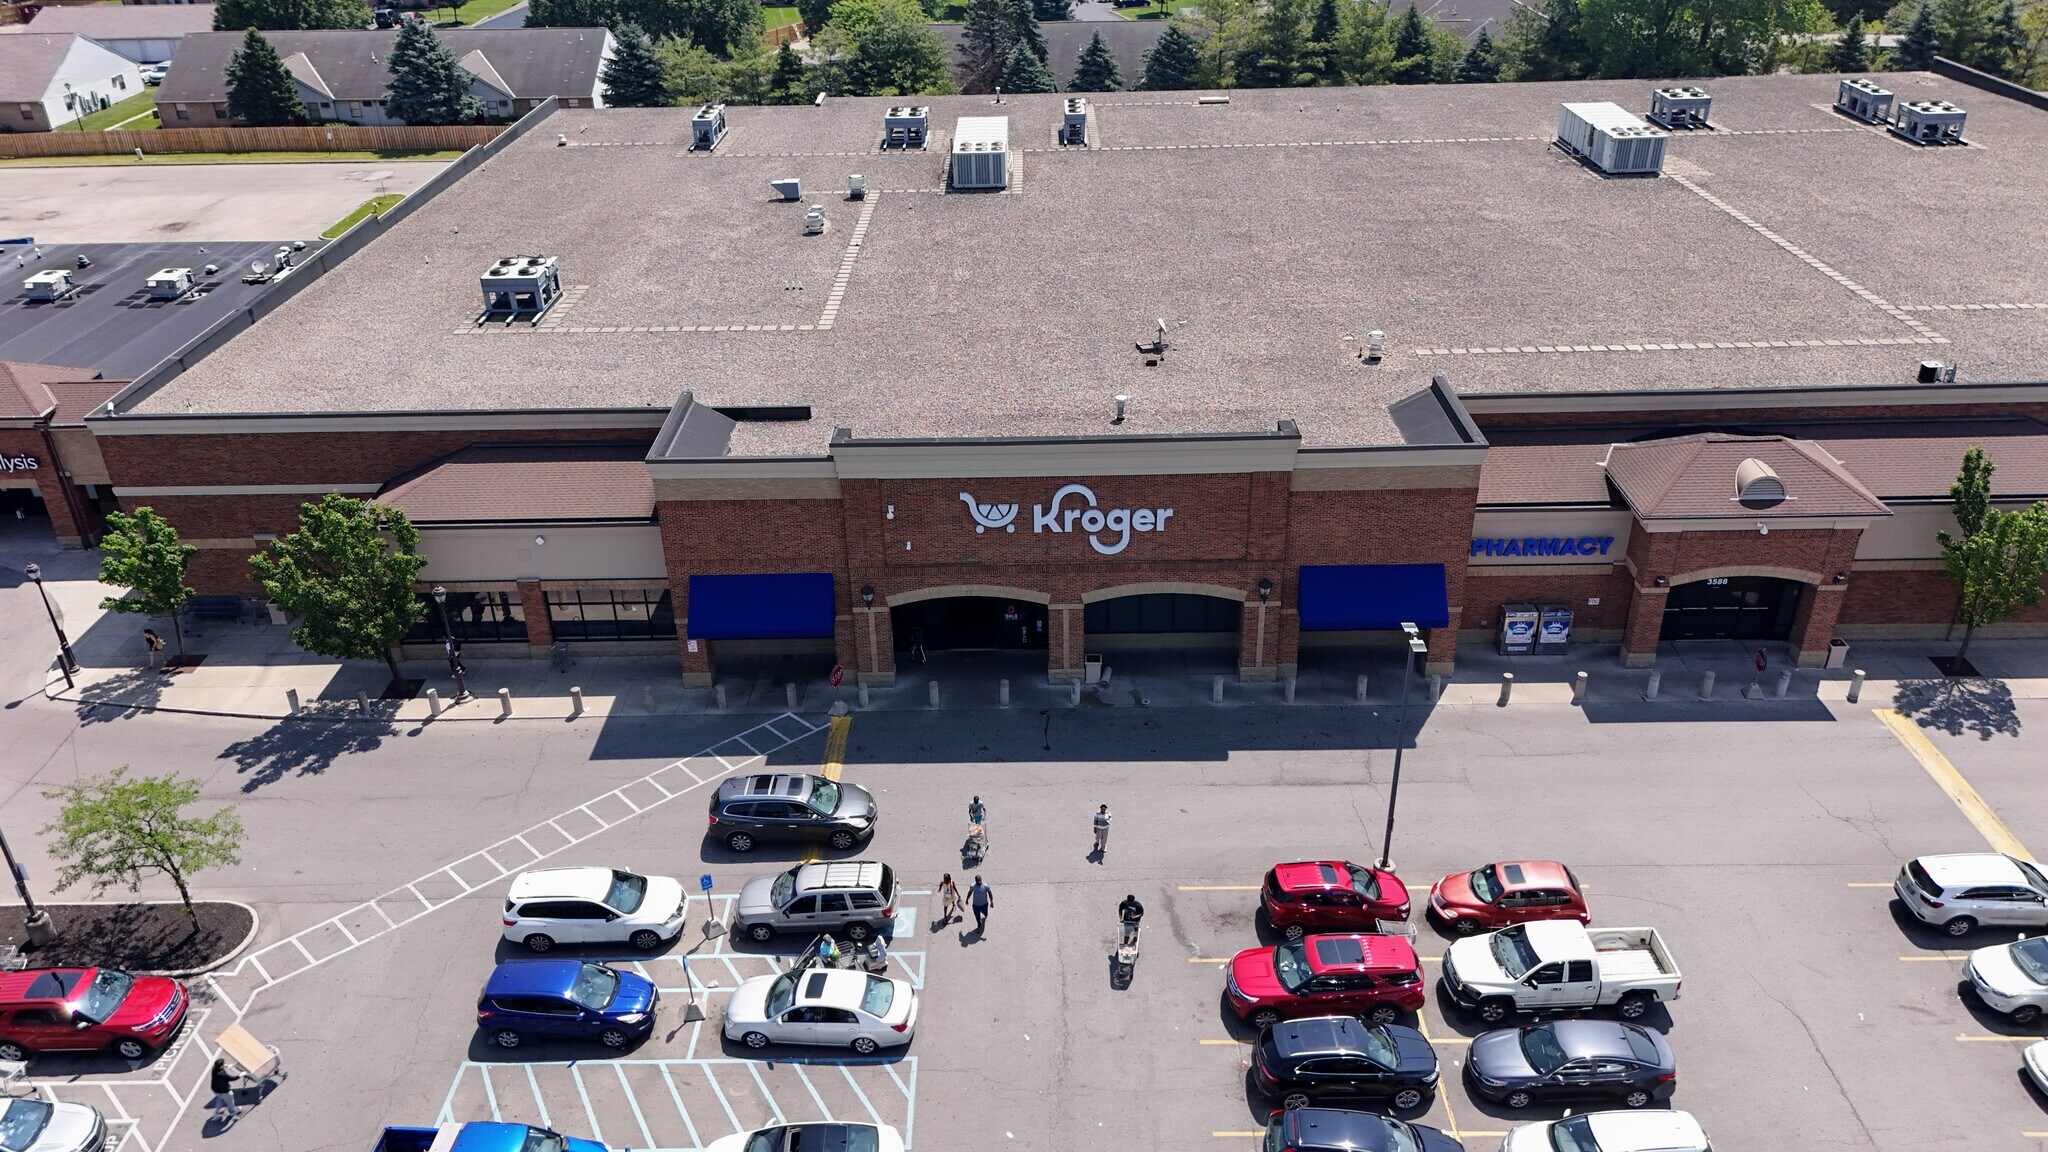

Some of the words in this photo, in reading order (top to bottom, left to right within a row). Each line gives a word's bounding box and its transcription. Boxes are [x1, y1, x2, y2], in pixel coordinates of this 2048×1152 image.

[0, 453, 38, 473] lysis
[1033, 483, 1174, 555] Kroger
[1471, 537, 1614, 557] PHARMACY
[153, 1039, 185, 1070] PICK
[179, 1019, 195, 1036] UP
